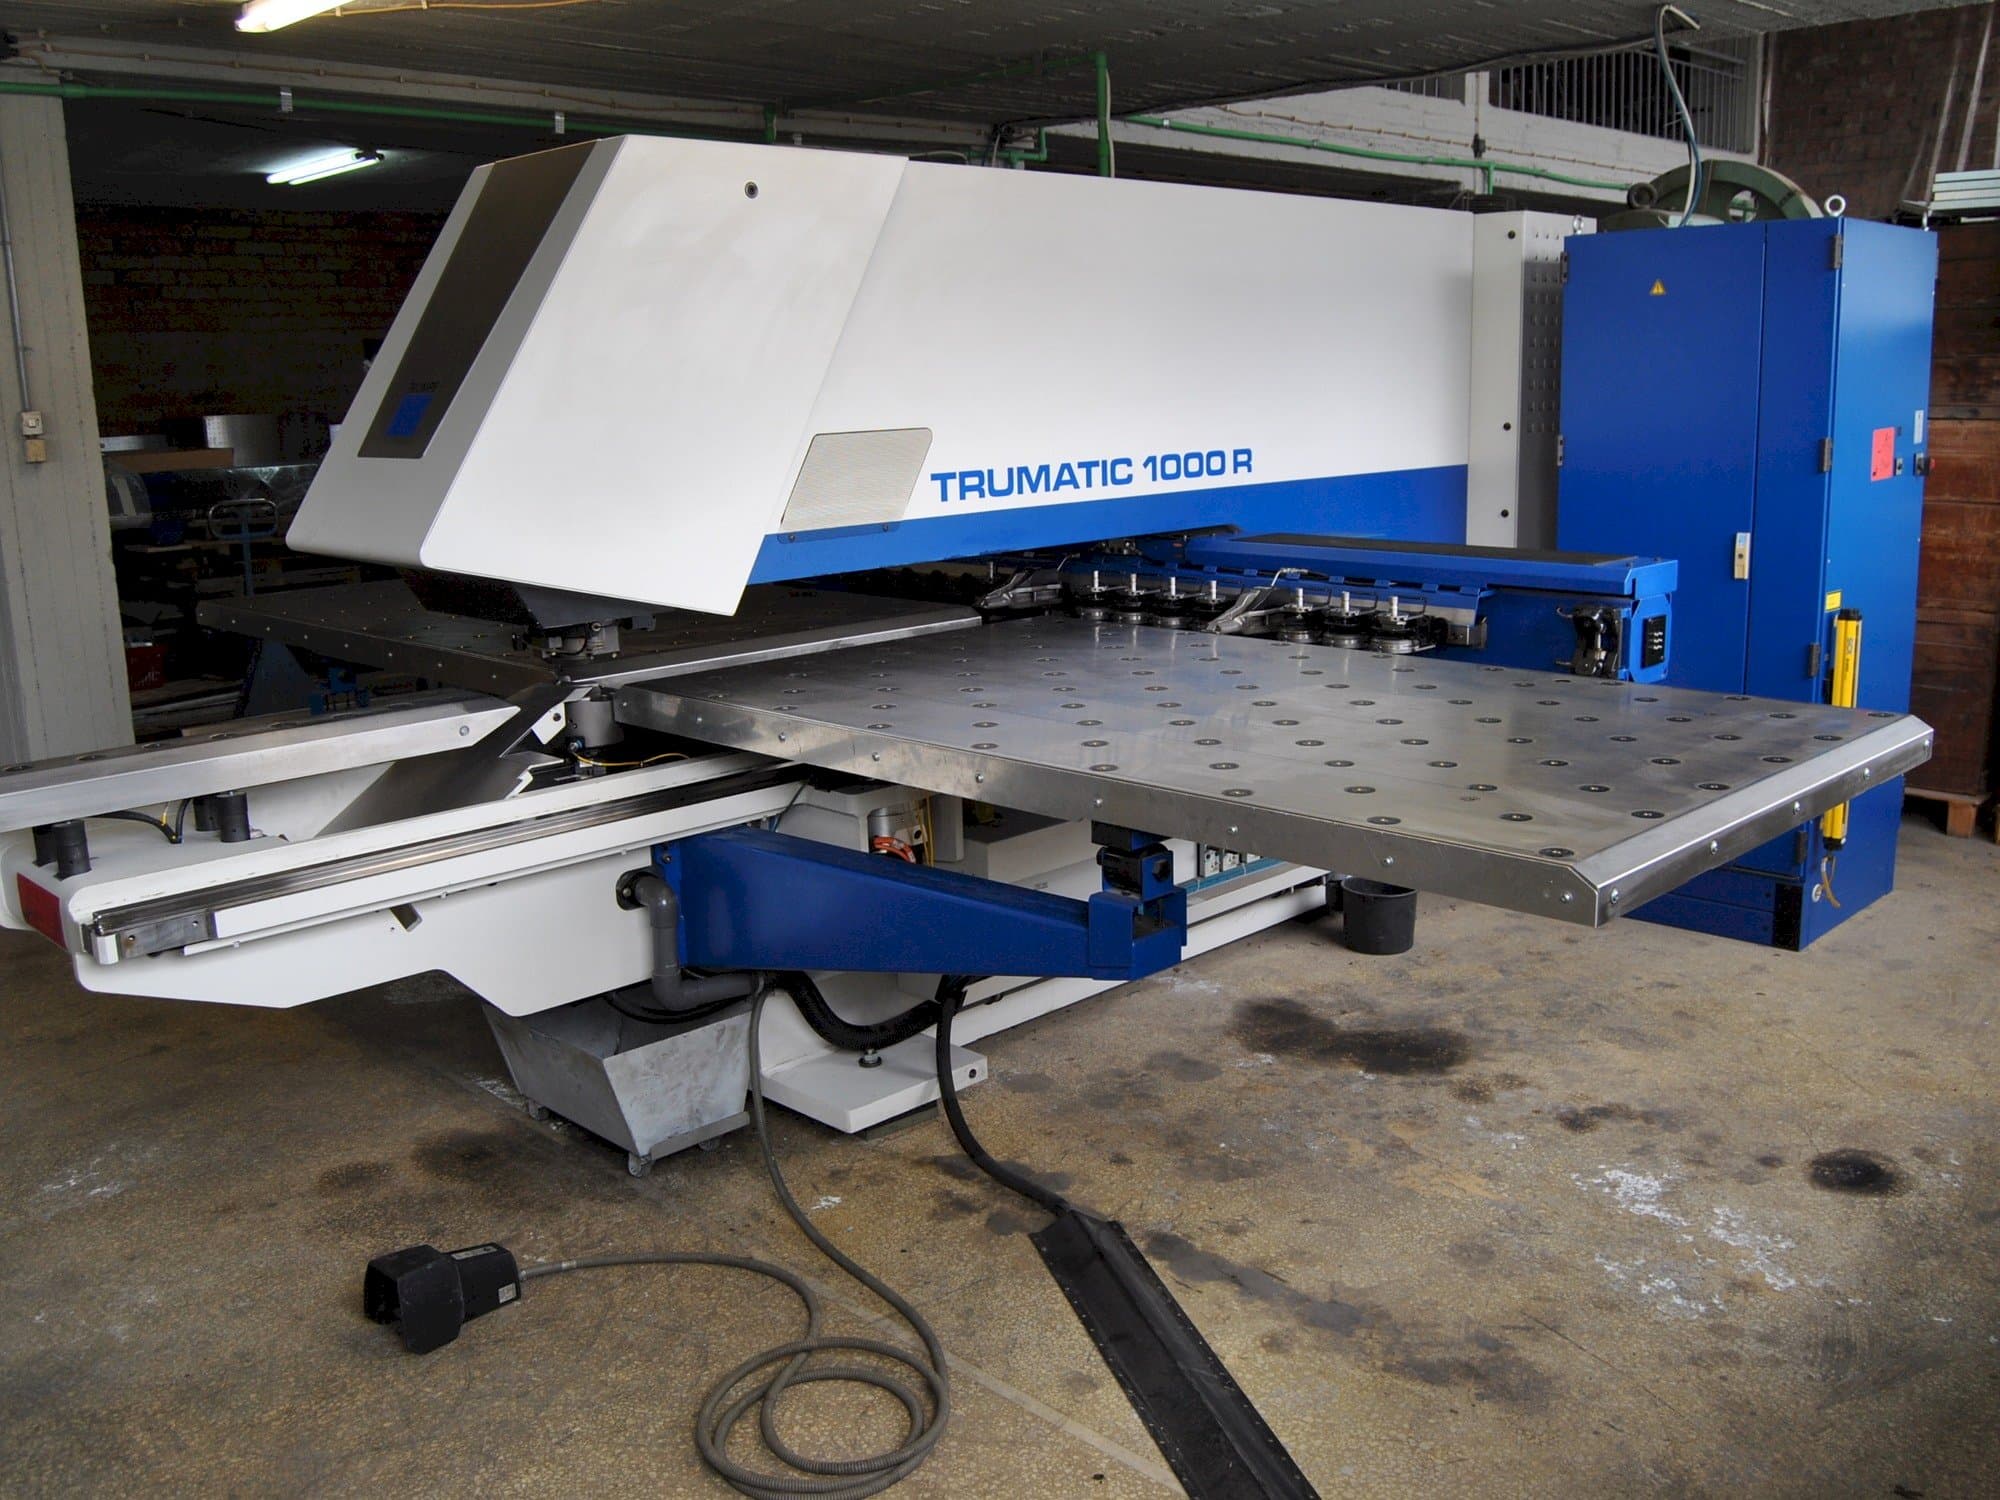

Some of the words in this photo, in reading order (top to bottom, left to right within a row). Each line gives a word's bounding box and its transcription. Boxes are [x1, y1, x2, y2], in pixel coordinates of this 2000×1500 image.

[930, 459, 1133, 502] TRUMATIC
[1142, 450, 1226, 482] 1000
[1232, 448, 1253, 474] R
